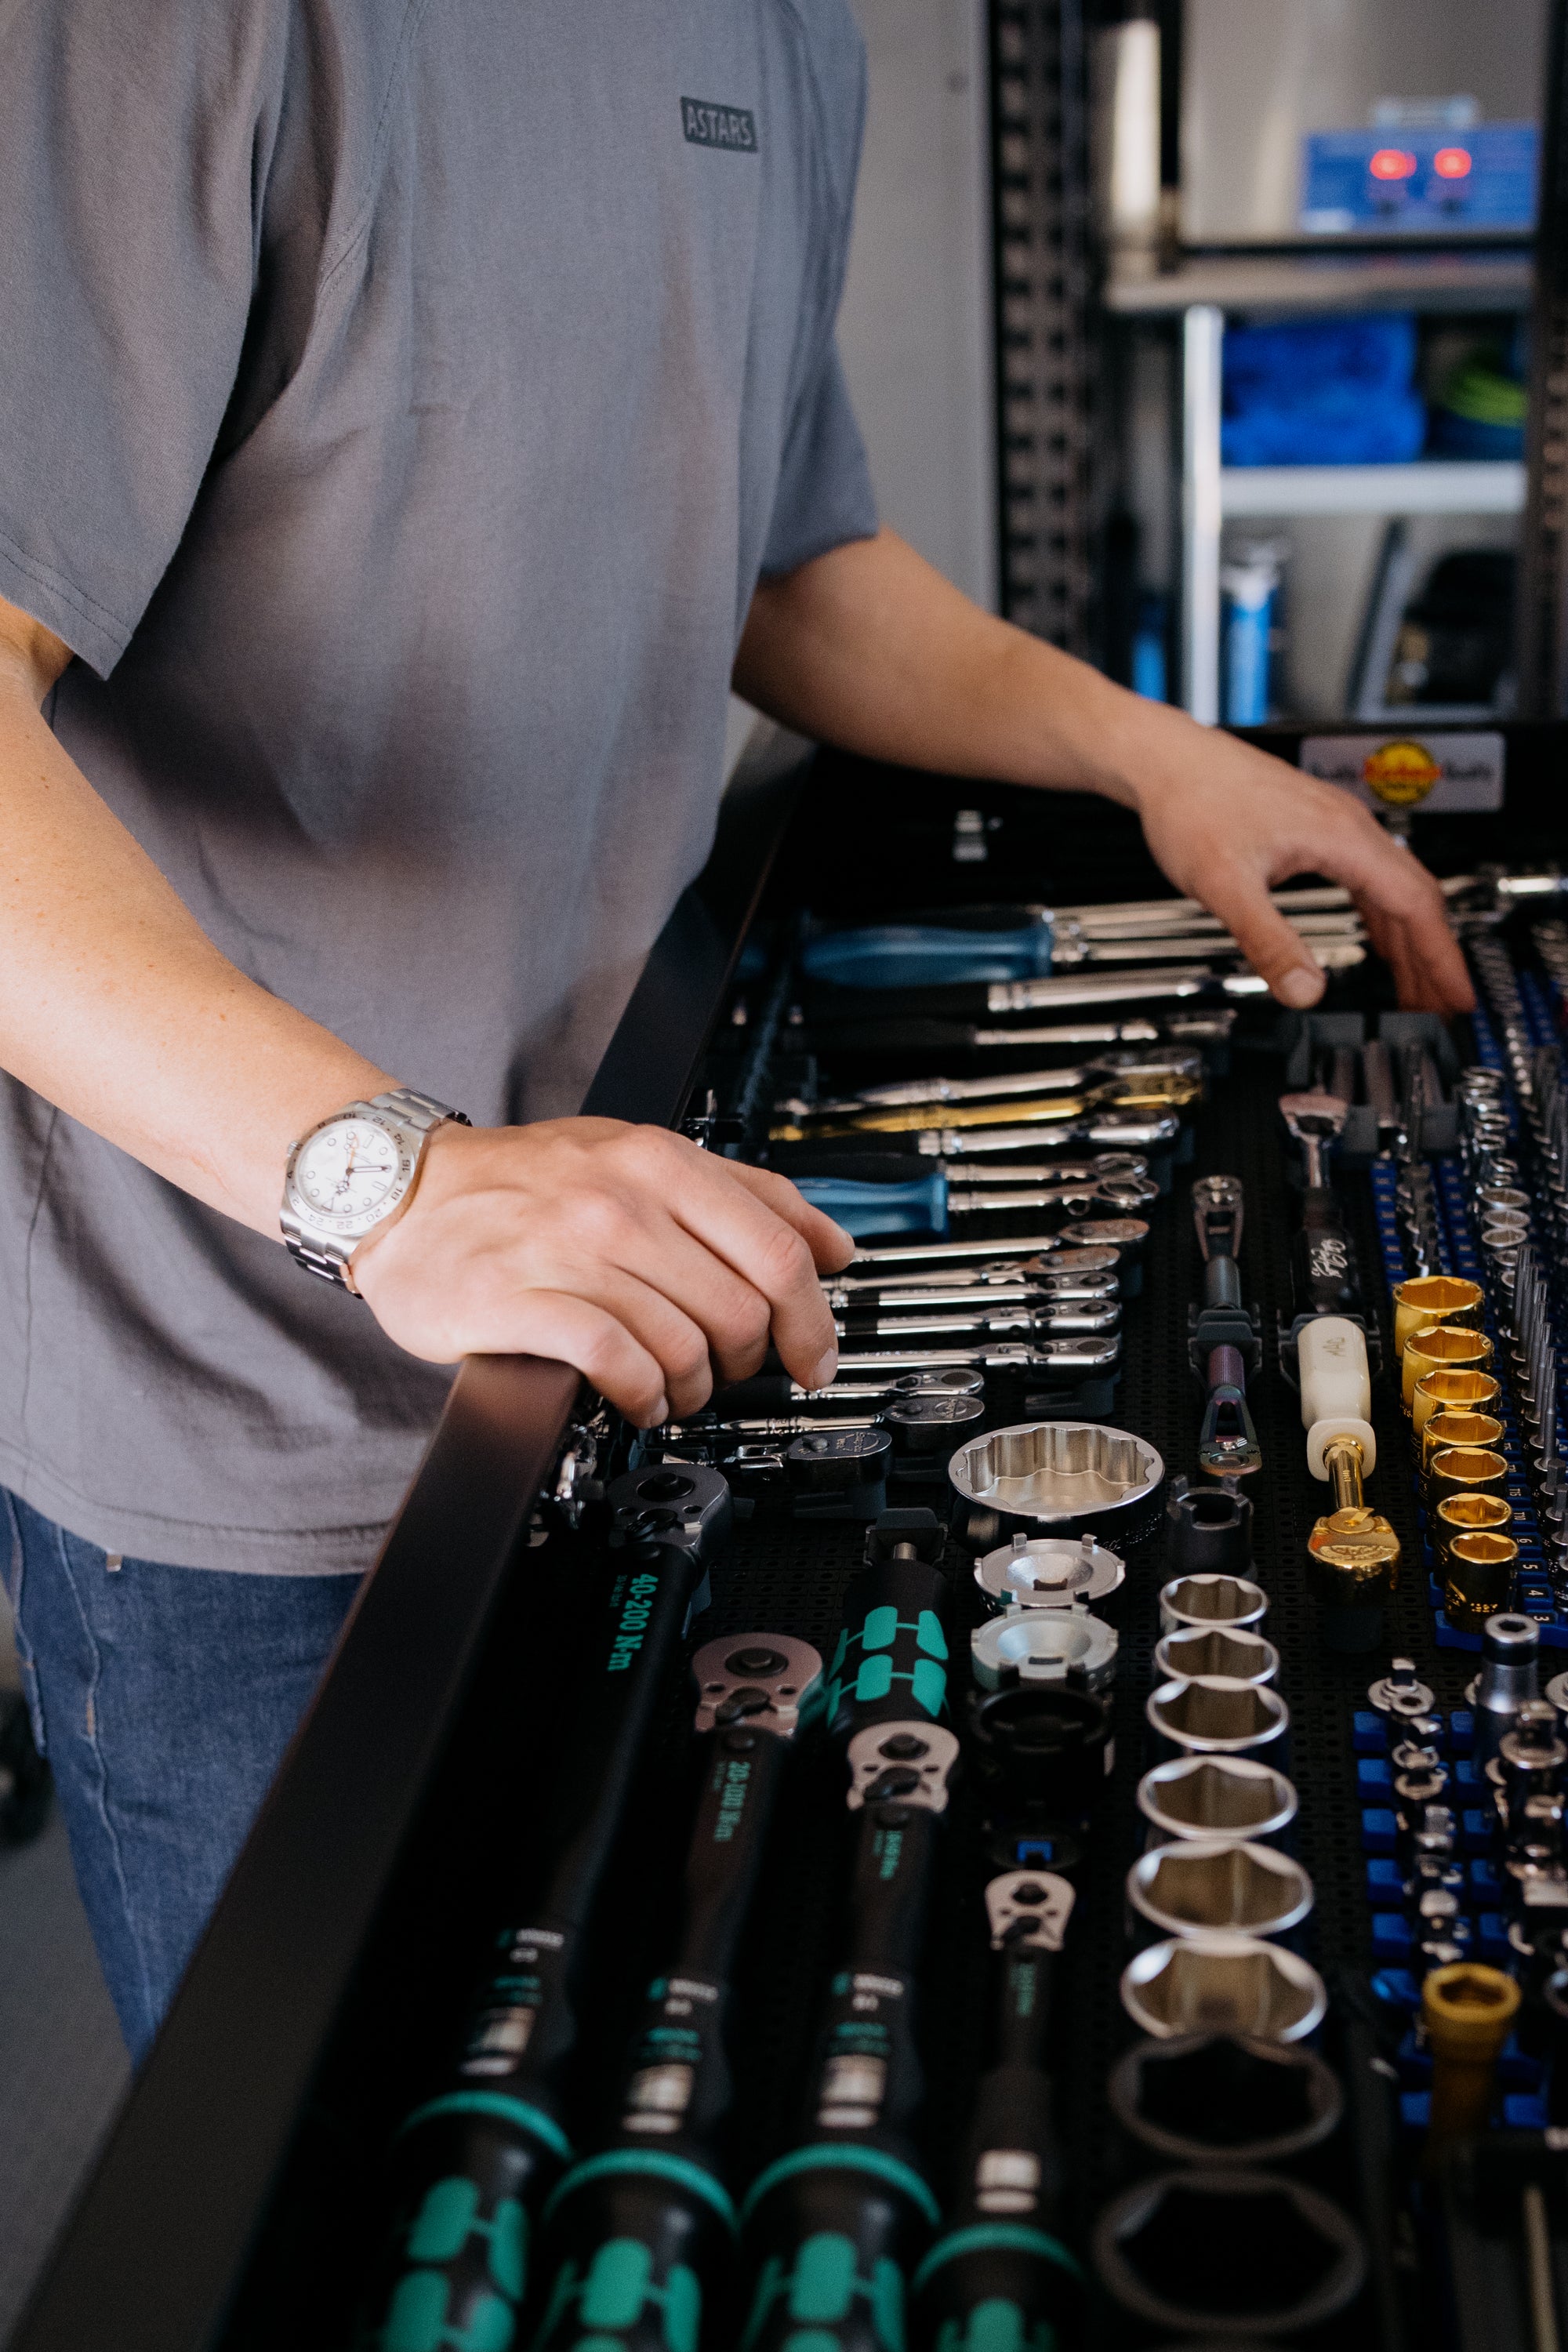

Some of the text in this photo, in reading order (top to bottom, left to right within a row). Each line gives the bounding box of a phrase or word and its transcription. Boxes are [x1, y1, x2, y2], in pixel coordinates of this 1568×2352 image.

[686, 105, 753, 146] ASTARS
[372, 1116, 386, 1126] 12
[394, 1133, 405, 1146] 14
[402, 1160, 411, 1172] 16
[366, 1208, 383, 1223] 20
[337, 1220, 354, 1229] 22
[1509, 1488, 1522, 1497] T15
[1514, 1512, 1526, 1521] T10
[619, 1573, 659, 1631] 40-200
